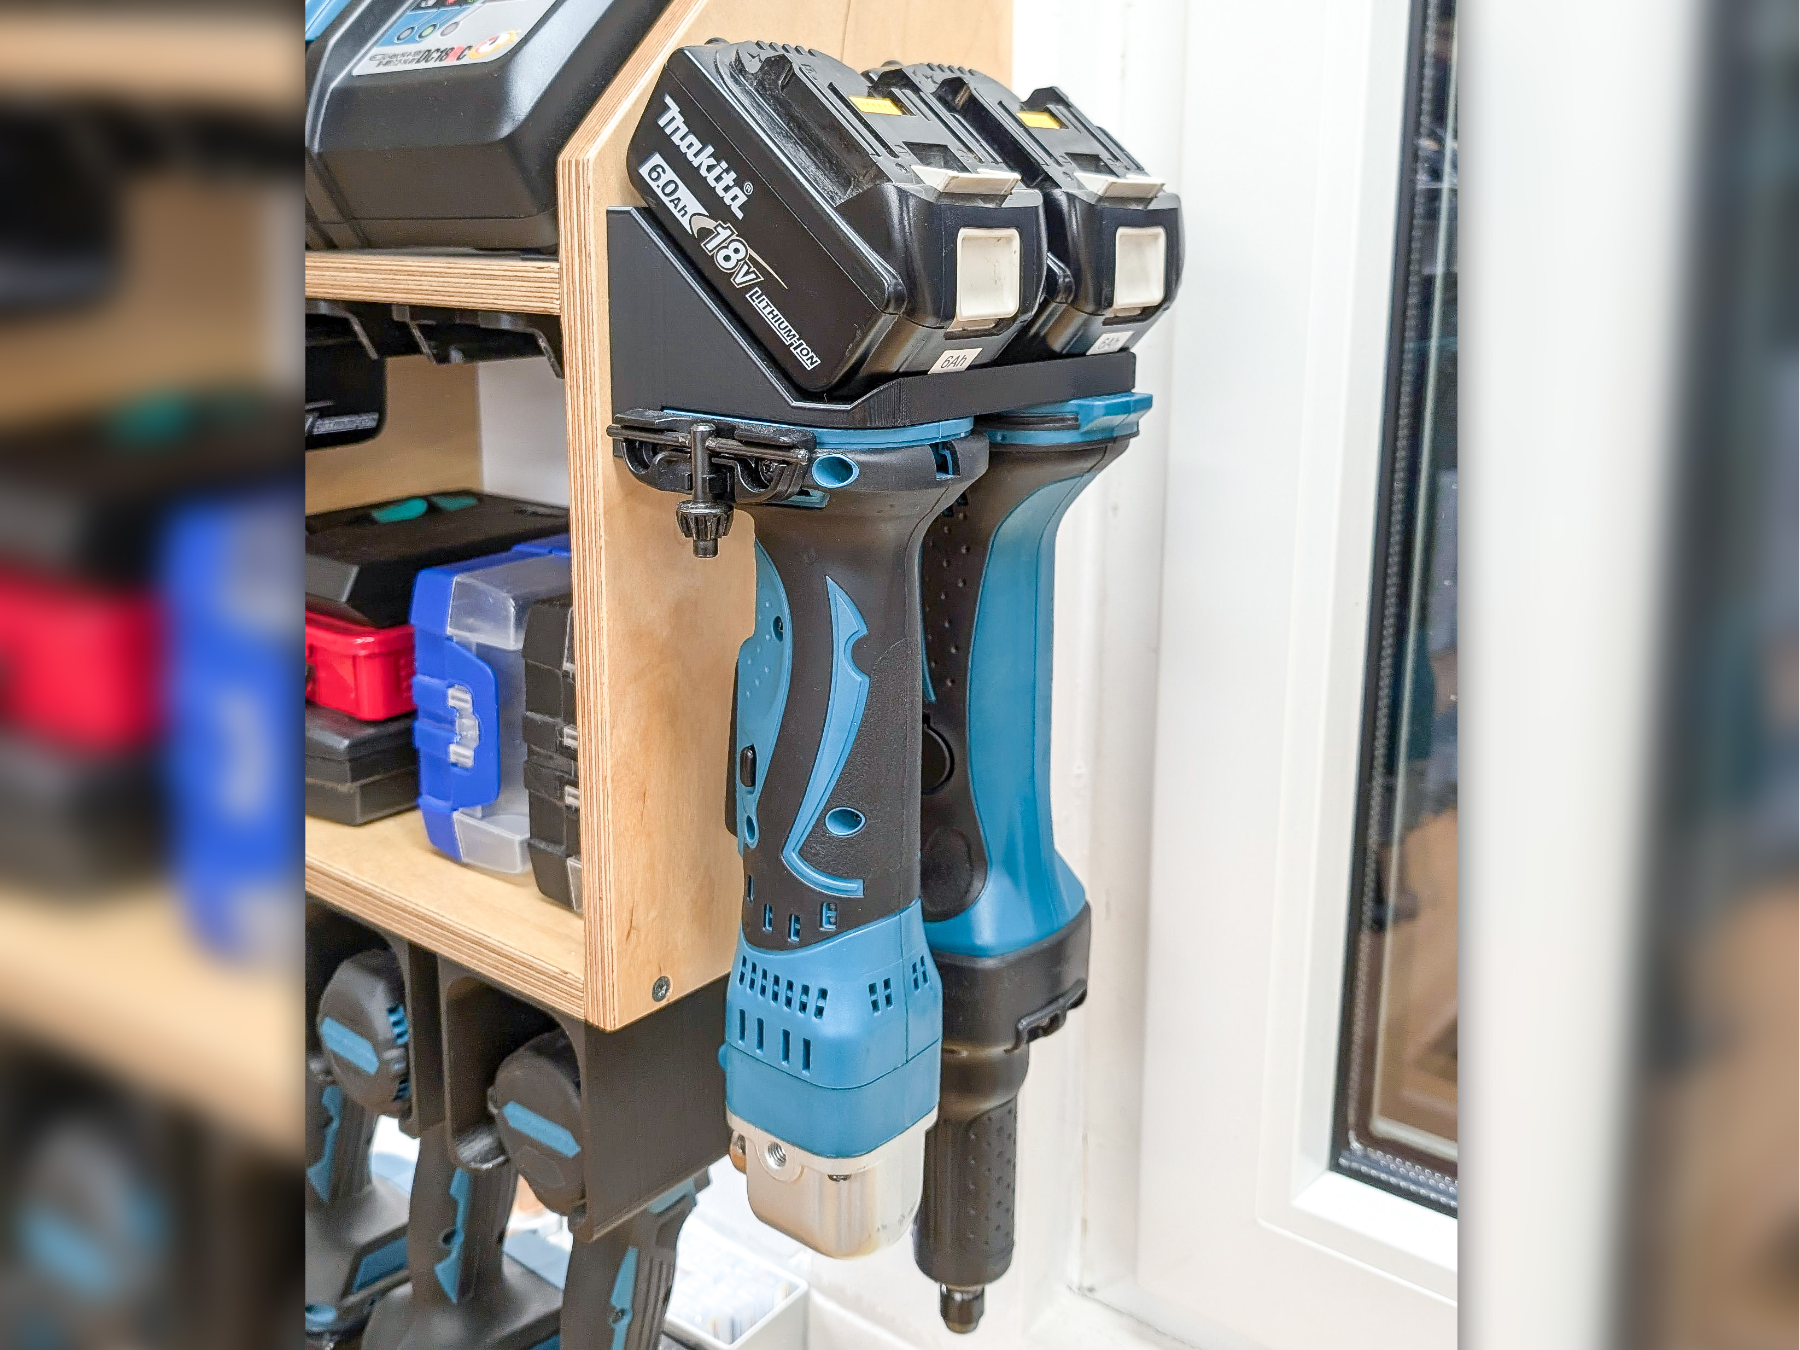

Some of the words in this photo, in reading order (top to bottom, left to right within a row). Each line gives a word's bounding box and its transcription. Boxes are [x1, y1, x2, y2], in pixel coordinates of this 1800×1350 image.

[646, 162, 689, 219] 6.0Ah
[746, 287, 820, 370] LITHIUM-ION
[940, 354, 967, 369] 6Ah
